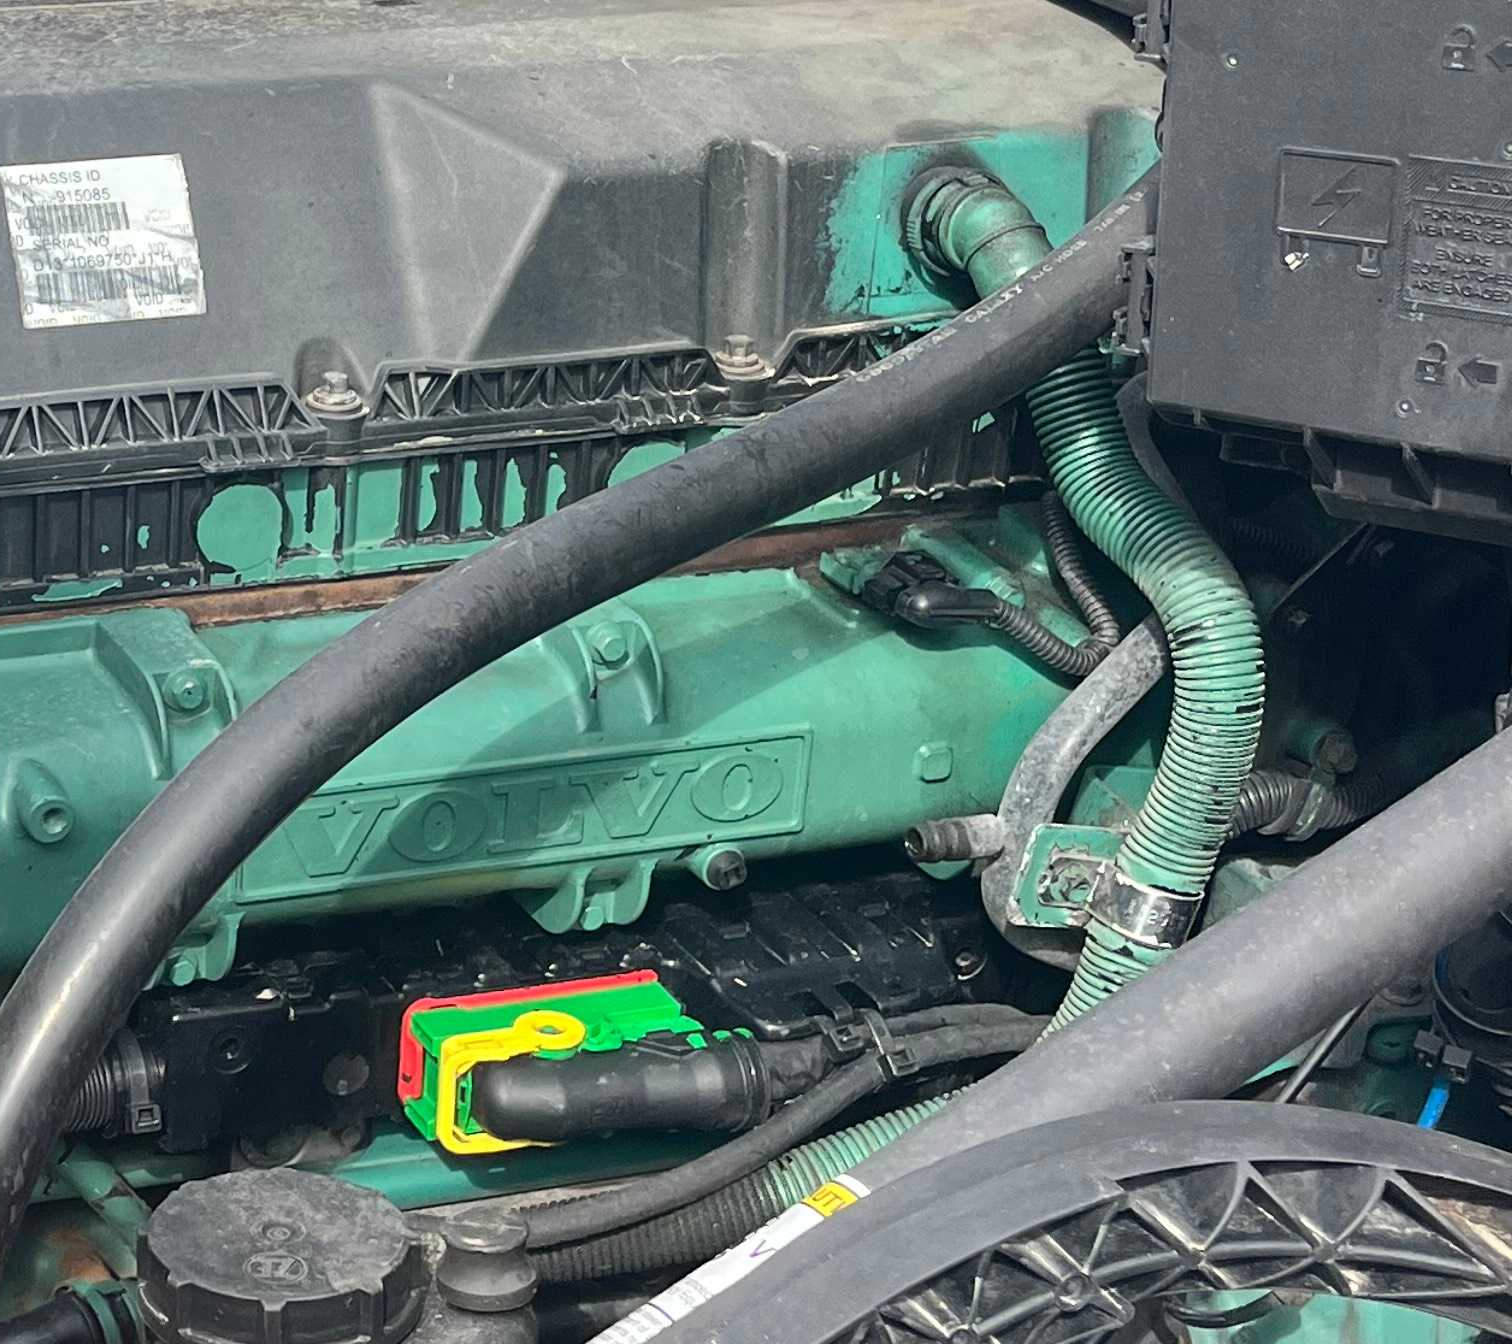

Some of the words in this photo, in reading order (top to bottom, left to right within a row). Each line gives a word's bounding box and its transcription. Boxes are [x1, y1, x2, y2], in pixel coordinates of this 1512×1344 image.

[19, 169, 83, 186] CHASSIS
[87, 169, 101, 182] ID
[33, 238, 83, 252] SERIAL
[287, 754, 783, 878] VOLVO
